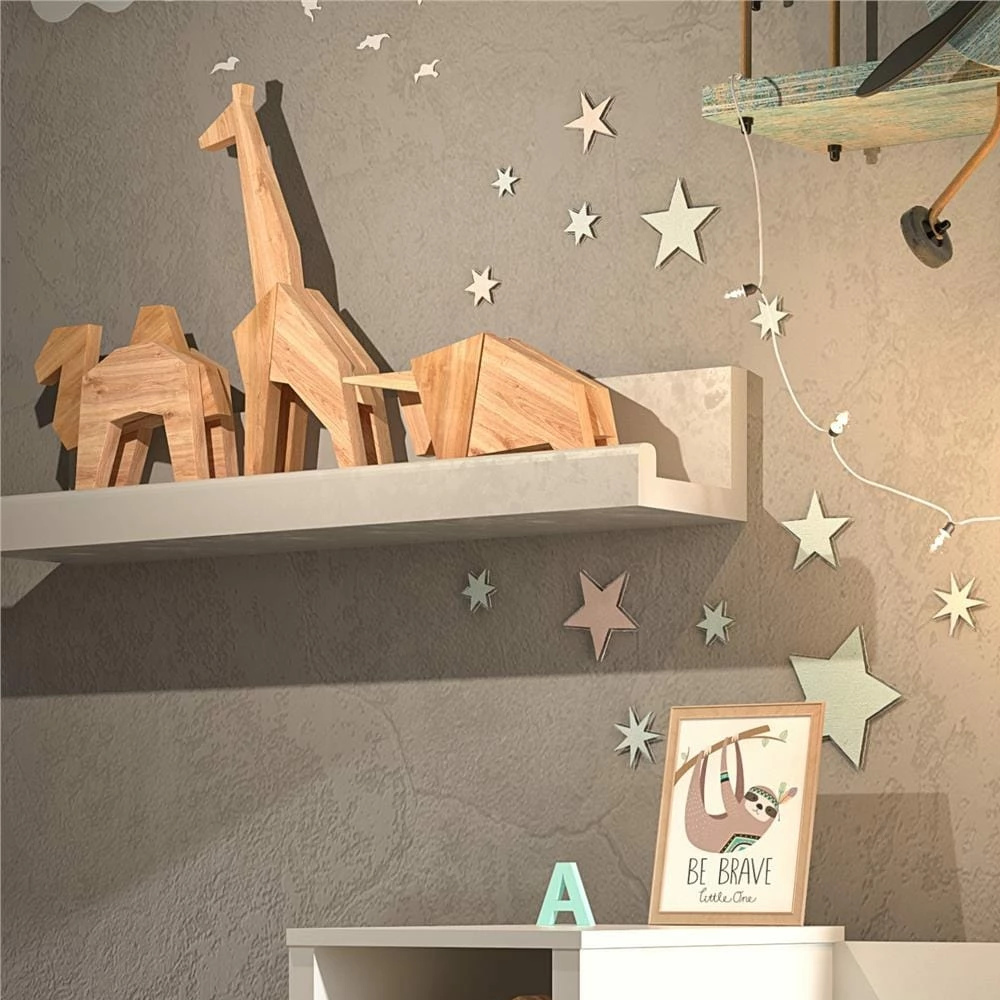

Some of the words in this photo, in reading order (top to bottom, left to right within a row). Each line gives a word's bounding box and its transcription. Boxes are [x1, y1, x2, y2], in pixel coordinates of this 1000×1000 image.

[687, 857, 708, 885] BE
[718, 857, 773, 885] BRAVE
[536, 862, 597, 928] A
[733, 890, 757, 903] One
